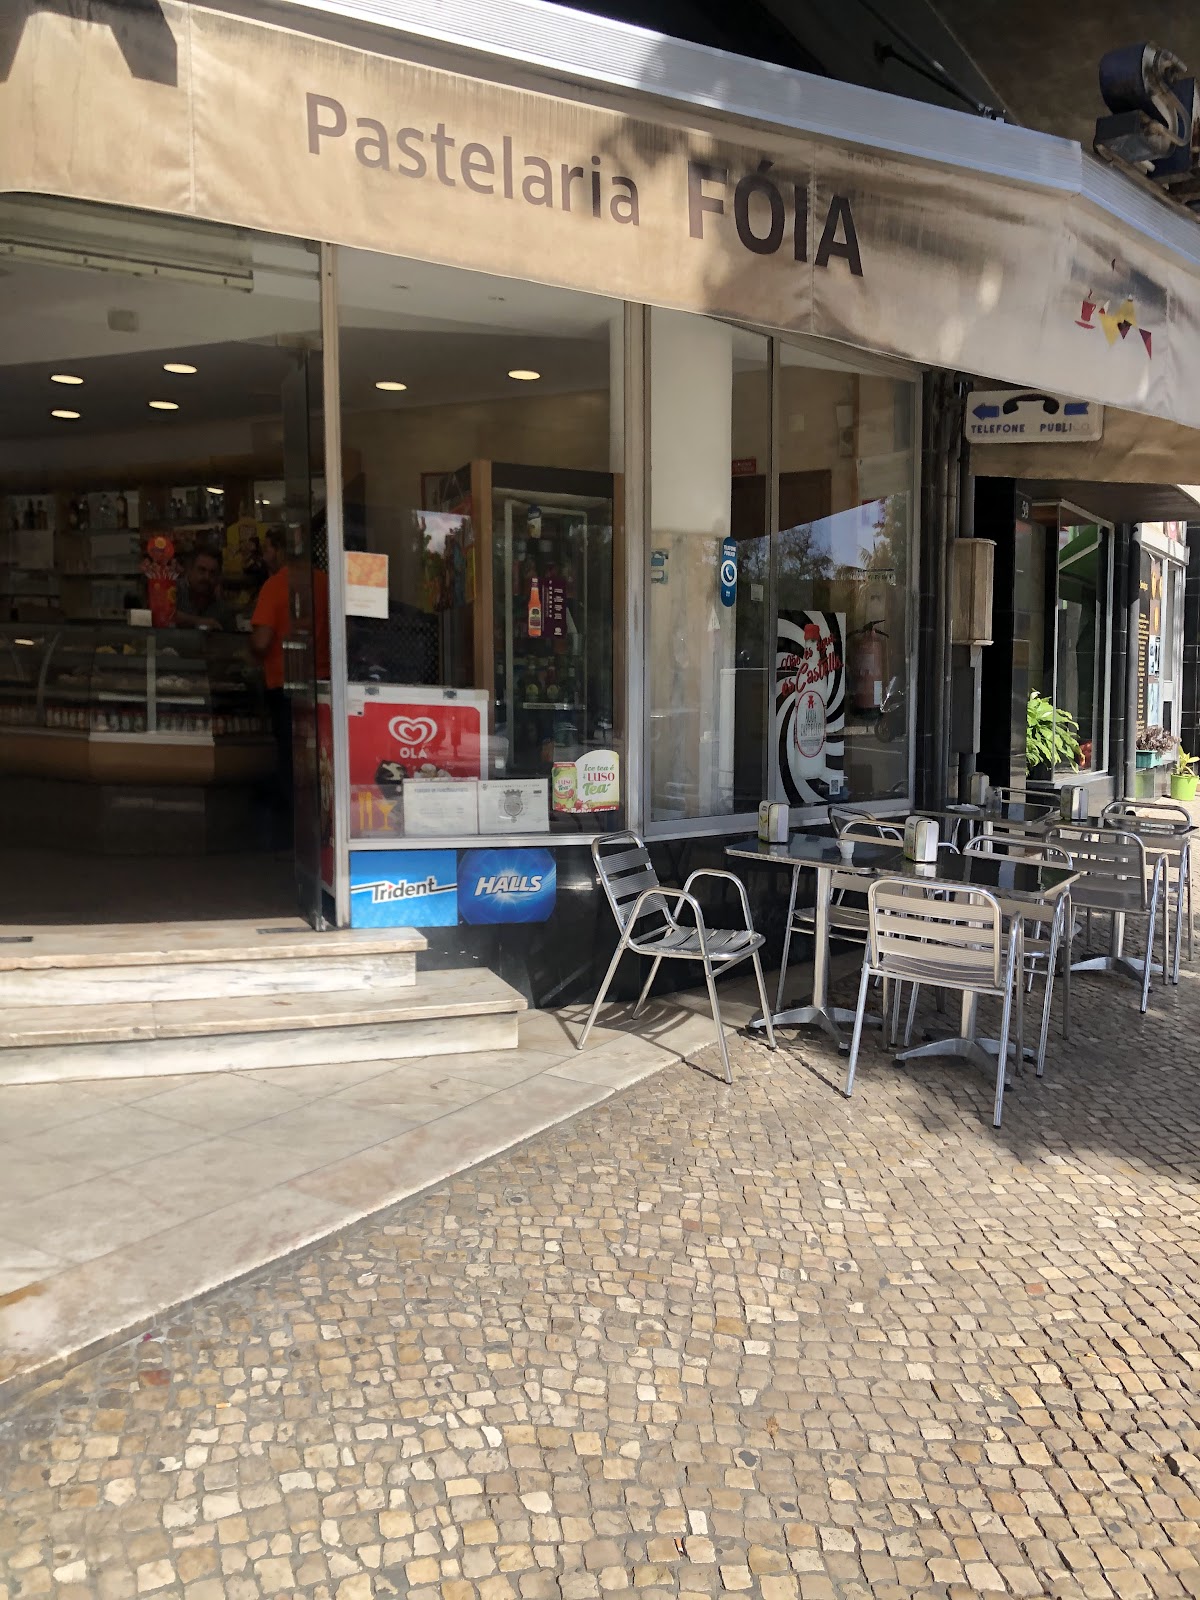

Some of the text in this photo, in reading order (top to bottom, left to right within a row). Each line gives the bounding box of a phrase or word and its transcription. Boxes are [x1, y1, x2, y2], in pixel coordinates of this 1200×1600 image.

[305, 91, 864, 277] Pastelaria FÓIA
[971, 423, 1026, 434] TELEFONE
[584, 763, 595, 772] Ice
[587, 772, 615, 782] LUSO
[582, 783, 611, 796] Tea
[372, 876, 436, 901] Trident
[474, 875, 543, 897] HALLS
